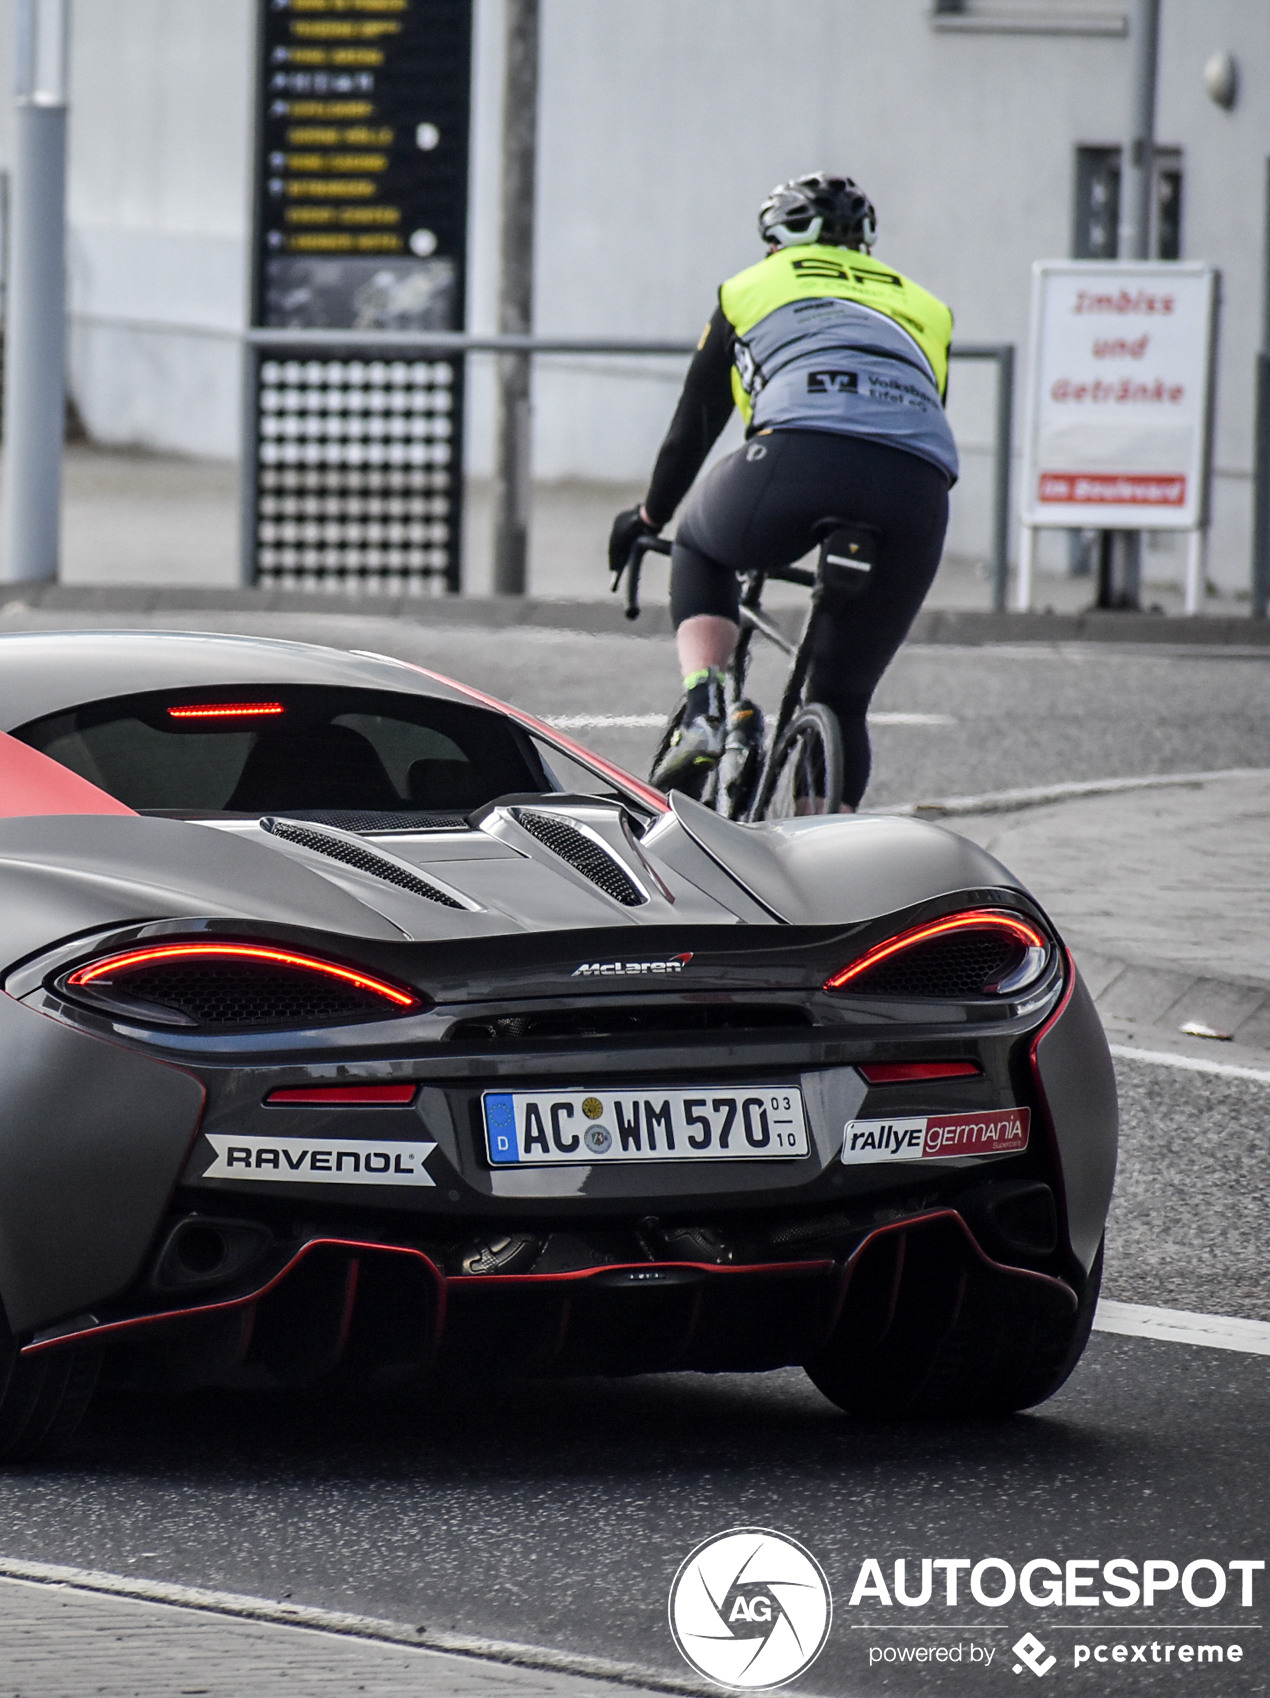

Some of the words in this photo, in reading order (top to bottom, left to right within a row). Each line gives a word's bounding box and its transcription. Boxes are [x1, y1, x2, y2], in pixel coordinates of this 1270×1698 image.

[792, 258, 903, 287] SP
[1073, 288, 1174, 316] Imbiss
[1093, 334, 1150, 360] und
[1050, 376, 1184, 404] Getränke
[571, 961, 682, 977] McLaren
[497, 1136, 509, 1151] D
[523, 1101, 580, 1154] AC
[771, 1096, 792, 1111] 03
[776, 1132, 797, 1148] 10
